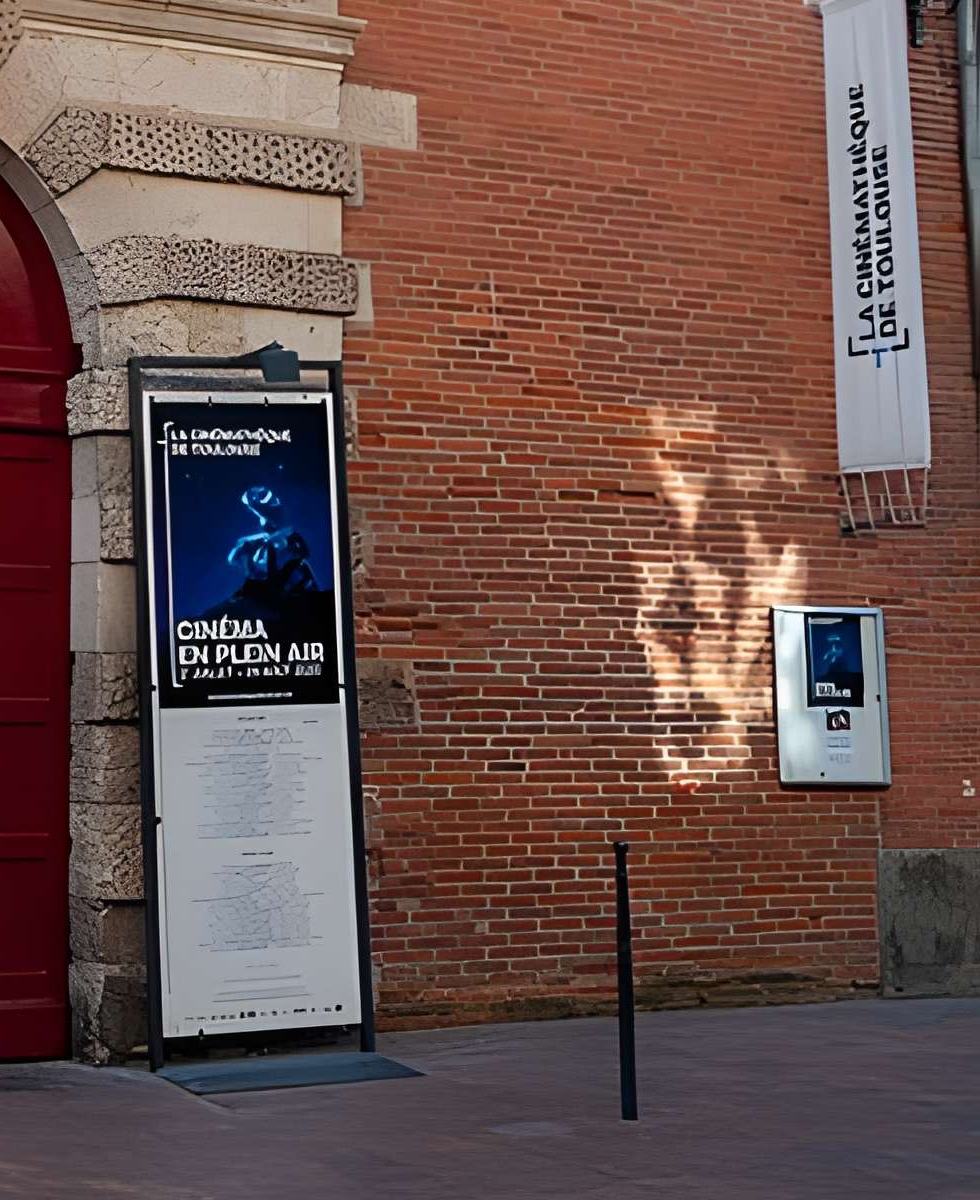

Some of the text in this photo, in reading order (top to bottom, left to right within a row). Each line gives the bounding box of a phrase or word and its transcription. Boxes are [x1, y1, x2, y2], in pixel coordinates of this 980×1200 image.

[858, 304, 876, 341] LA
[877, 300, 897, 338] DE
[287, 642, 324, 663] AIR
